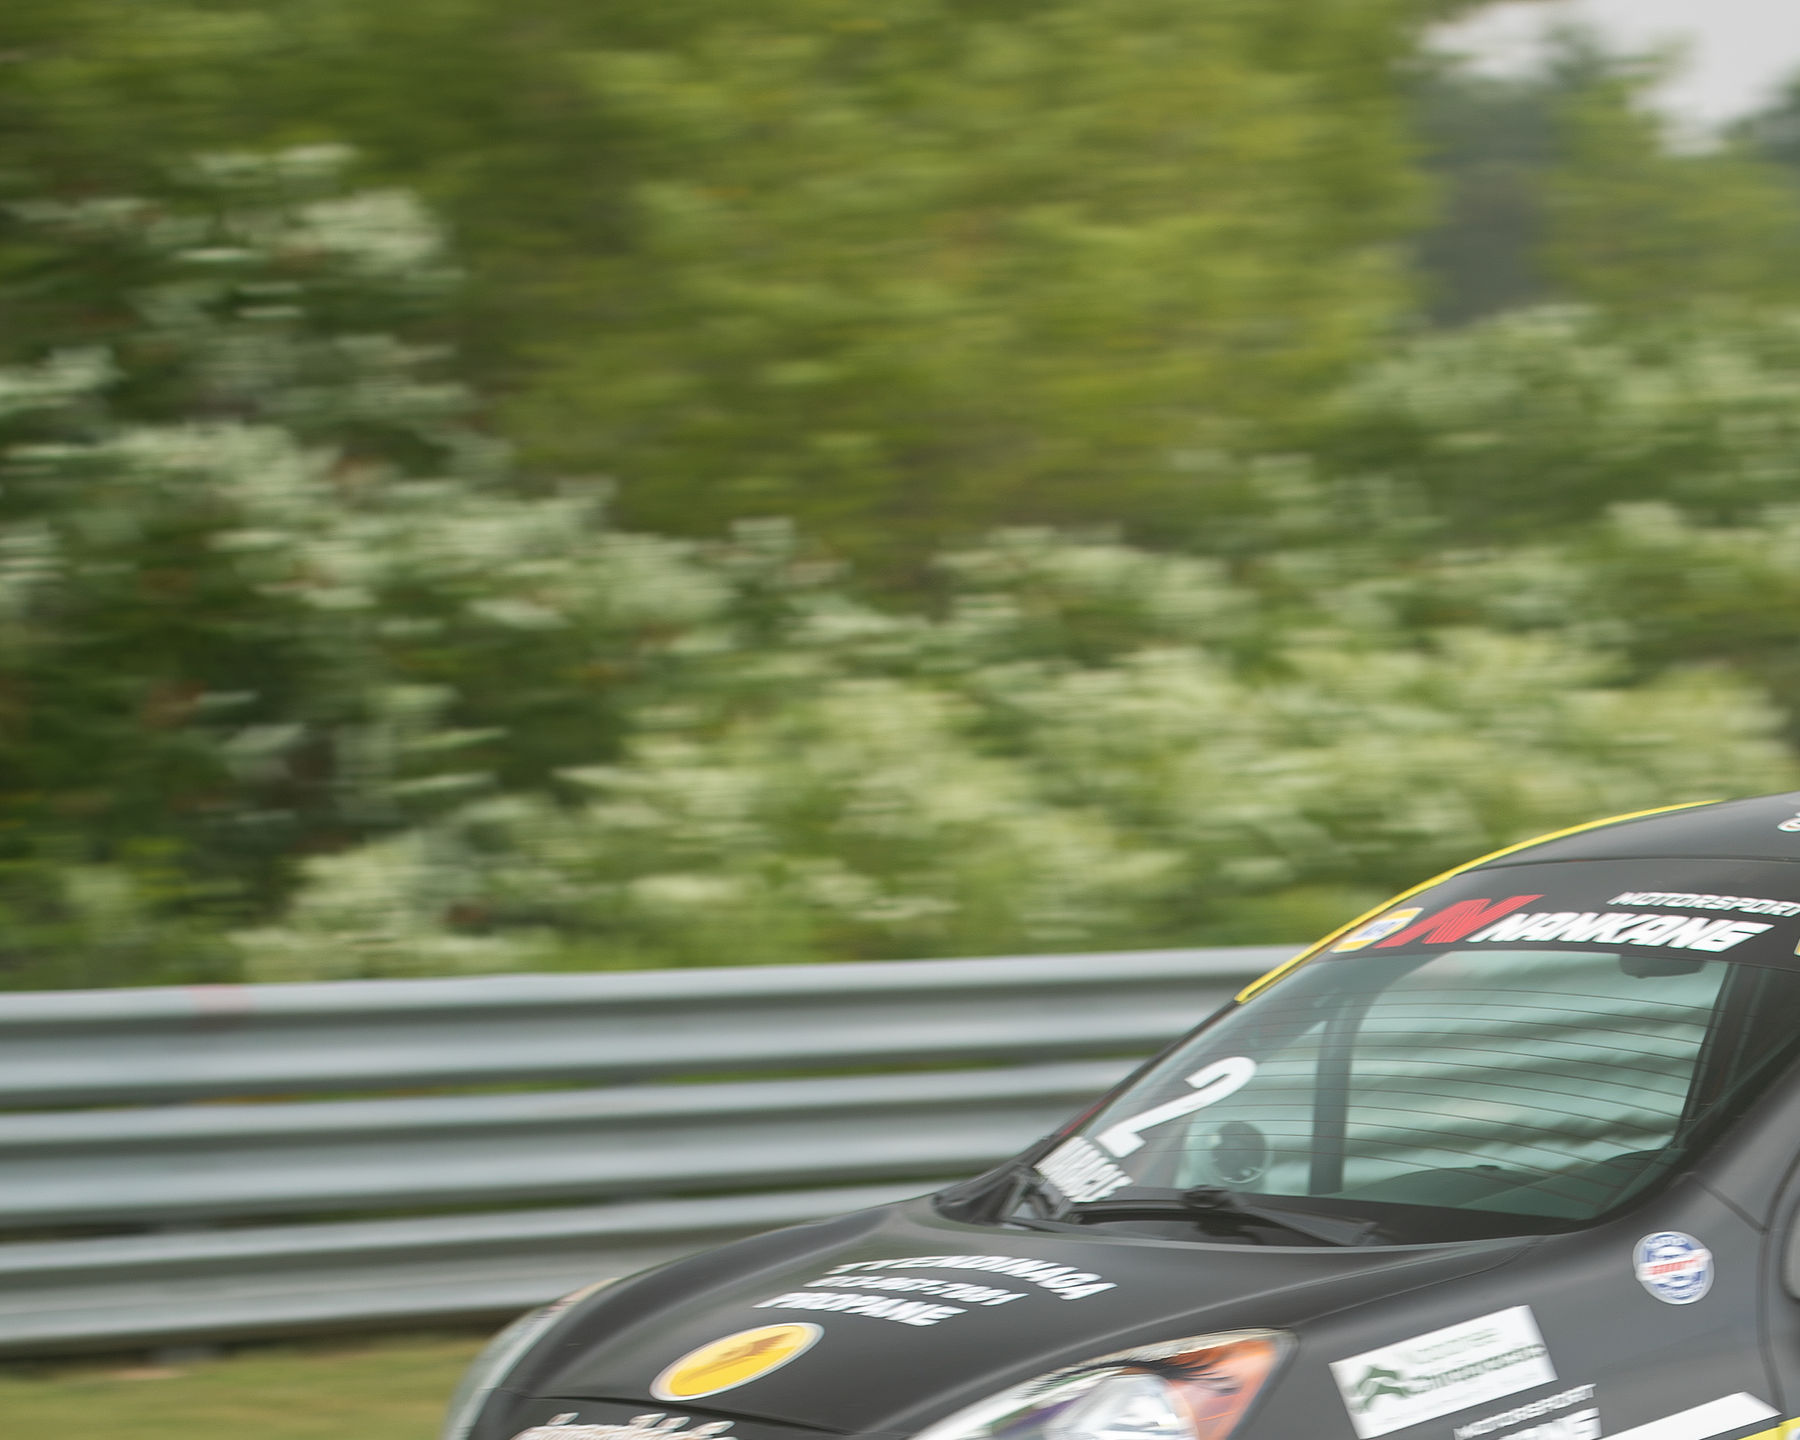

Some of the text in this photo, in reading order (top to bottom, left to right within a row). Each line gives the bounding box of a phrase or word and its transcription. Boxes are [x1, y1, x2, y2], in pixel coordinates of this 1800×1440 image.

[1465, 911, 1775, 952] NANKANG
[1095, 1056, 1257, 1158] 2
[752, 1292, 969, 1327] PROPANE
